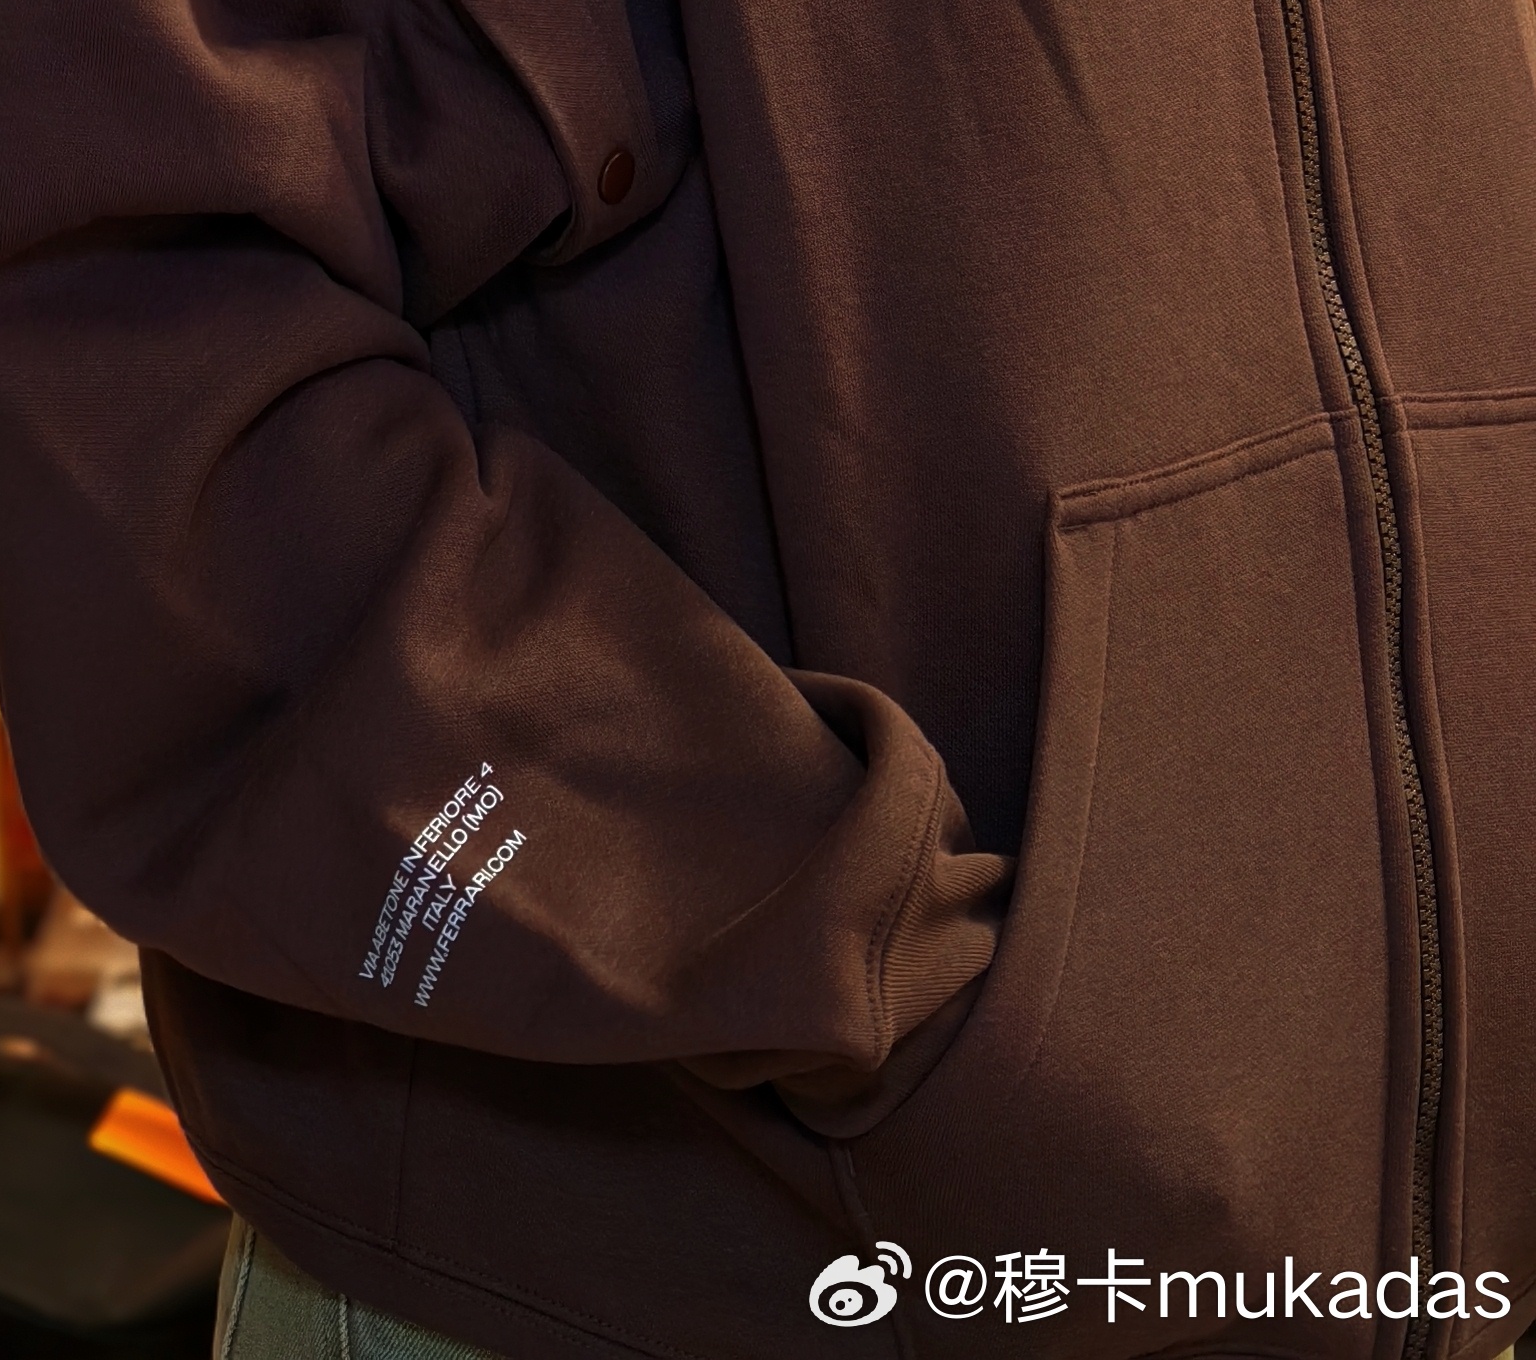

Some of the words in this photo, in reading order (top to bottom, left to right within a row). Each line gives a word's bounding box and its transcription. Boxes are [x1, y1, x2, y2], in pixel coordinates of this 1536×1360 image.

[359, 951, 381, 979] VIA
[372, 869, 410, 956] ABETONE
[400, 775, 482, 874] INFERIORE
[481, 761, 494, 778] 4
[380, 936, 404, 988] 41053
[395, 828, 468, 940] MARANELLO
[462, 784, 504, 831] (MO)
[413, 829, 527, 1007] WWW.FERRARI.COM
[422, 873, 458, 931] ITALY
